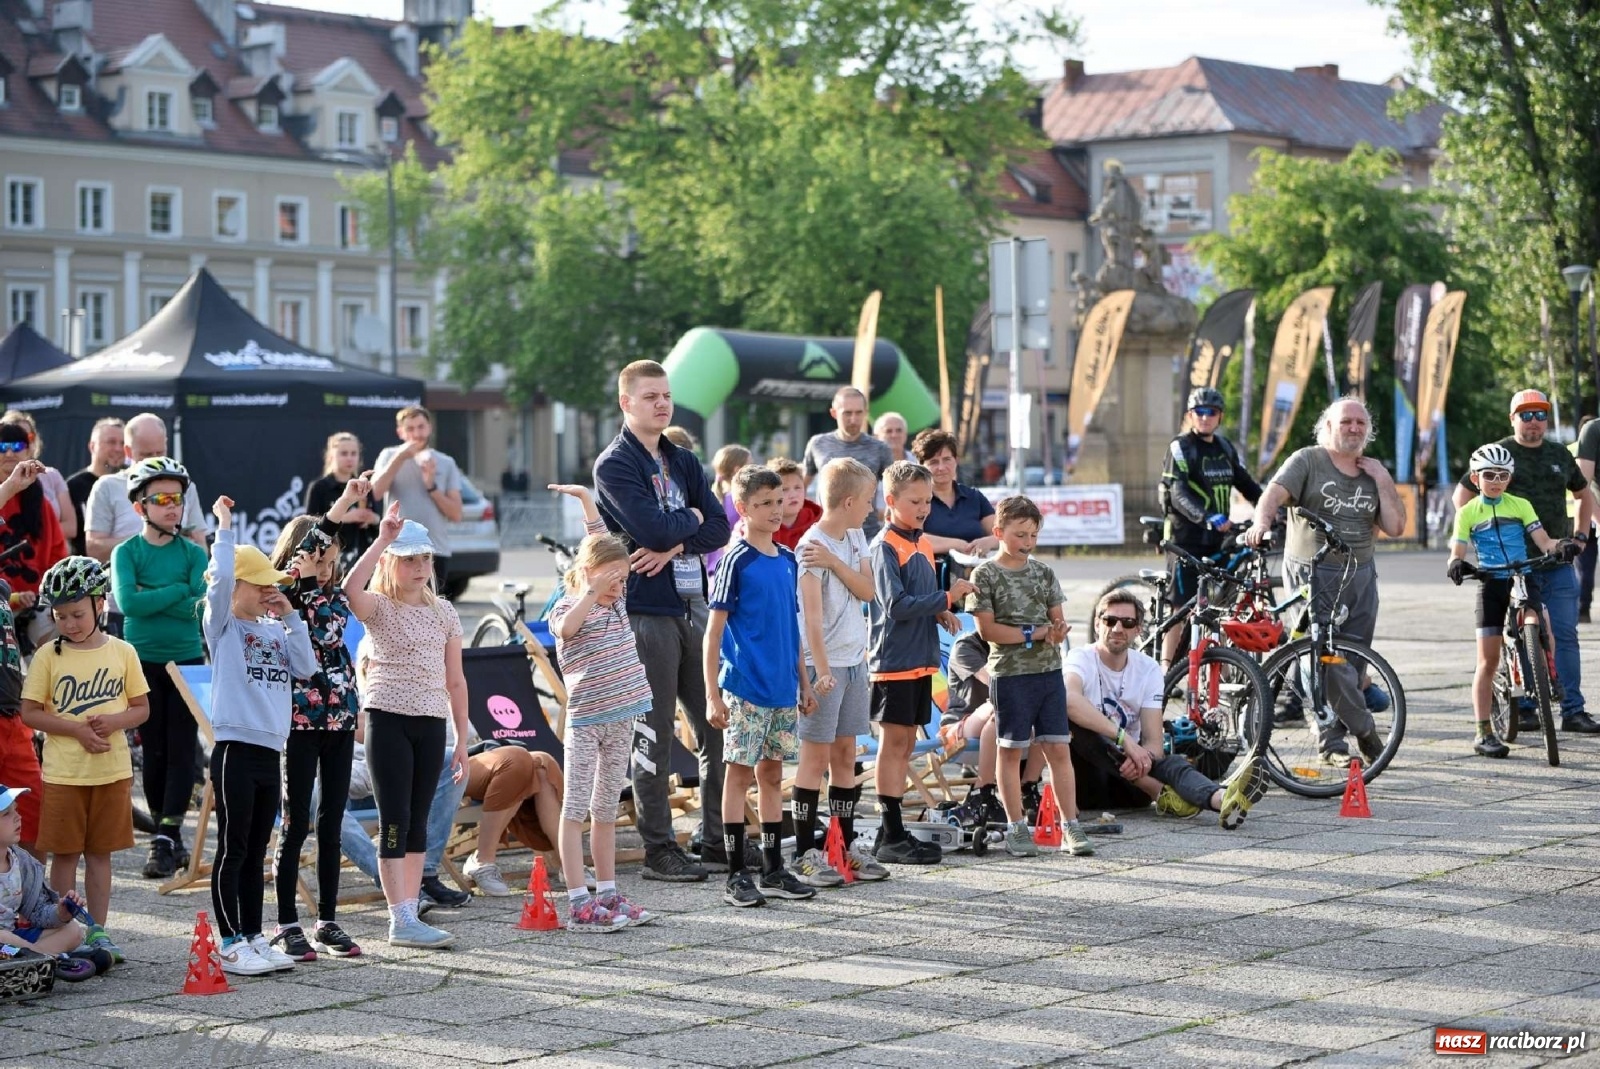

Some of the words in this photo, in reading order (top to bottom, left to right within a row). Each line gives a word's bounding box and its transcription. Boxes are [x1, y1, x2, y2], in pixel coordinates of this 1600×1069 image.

[1320, 481, 1376, 515] Signature
[52, 667, 124, 713] Dallas
[639, 738, 649, 756] OFF
[829, 798, 853, 812] VELO
